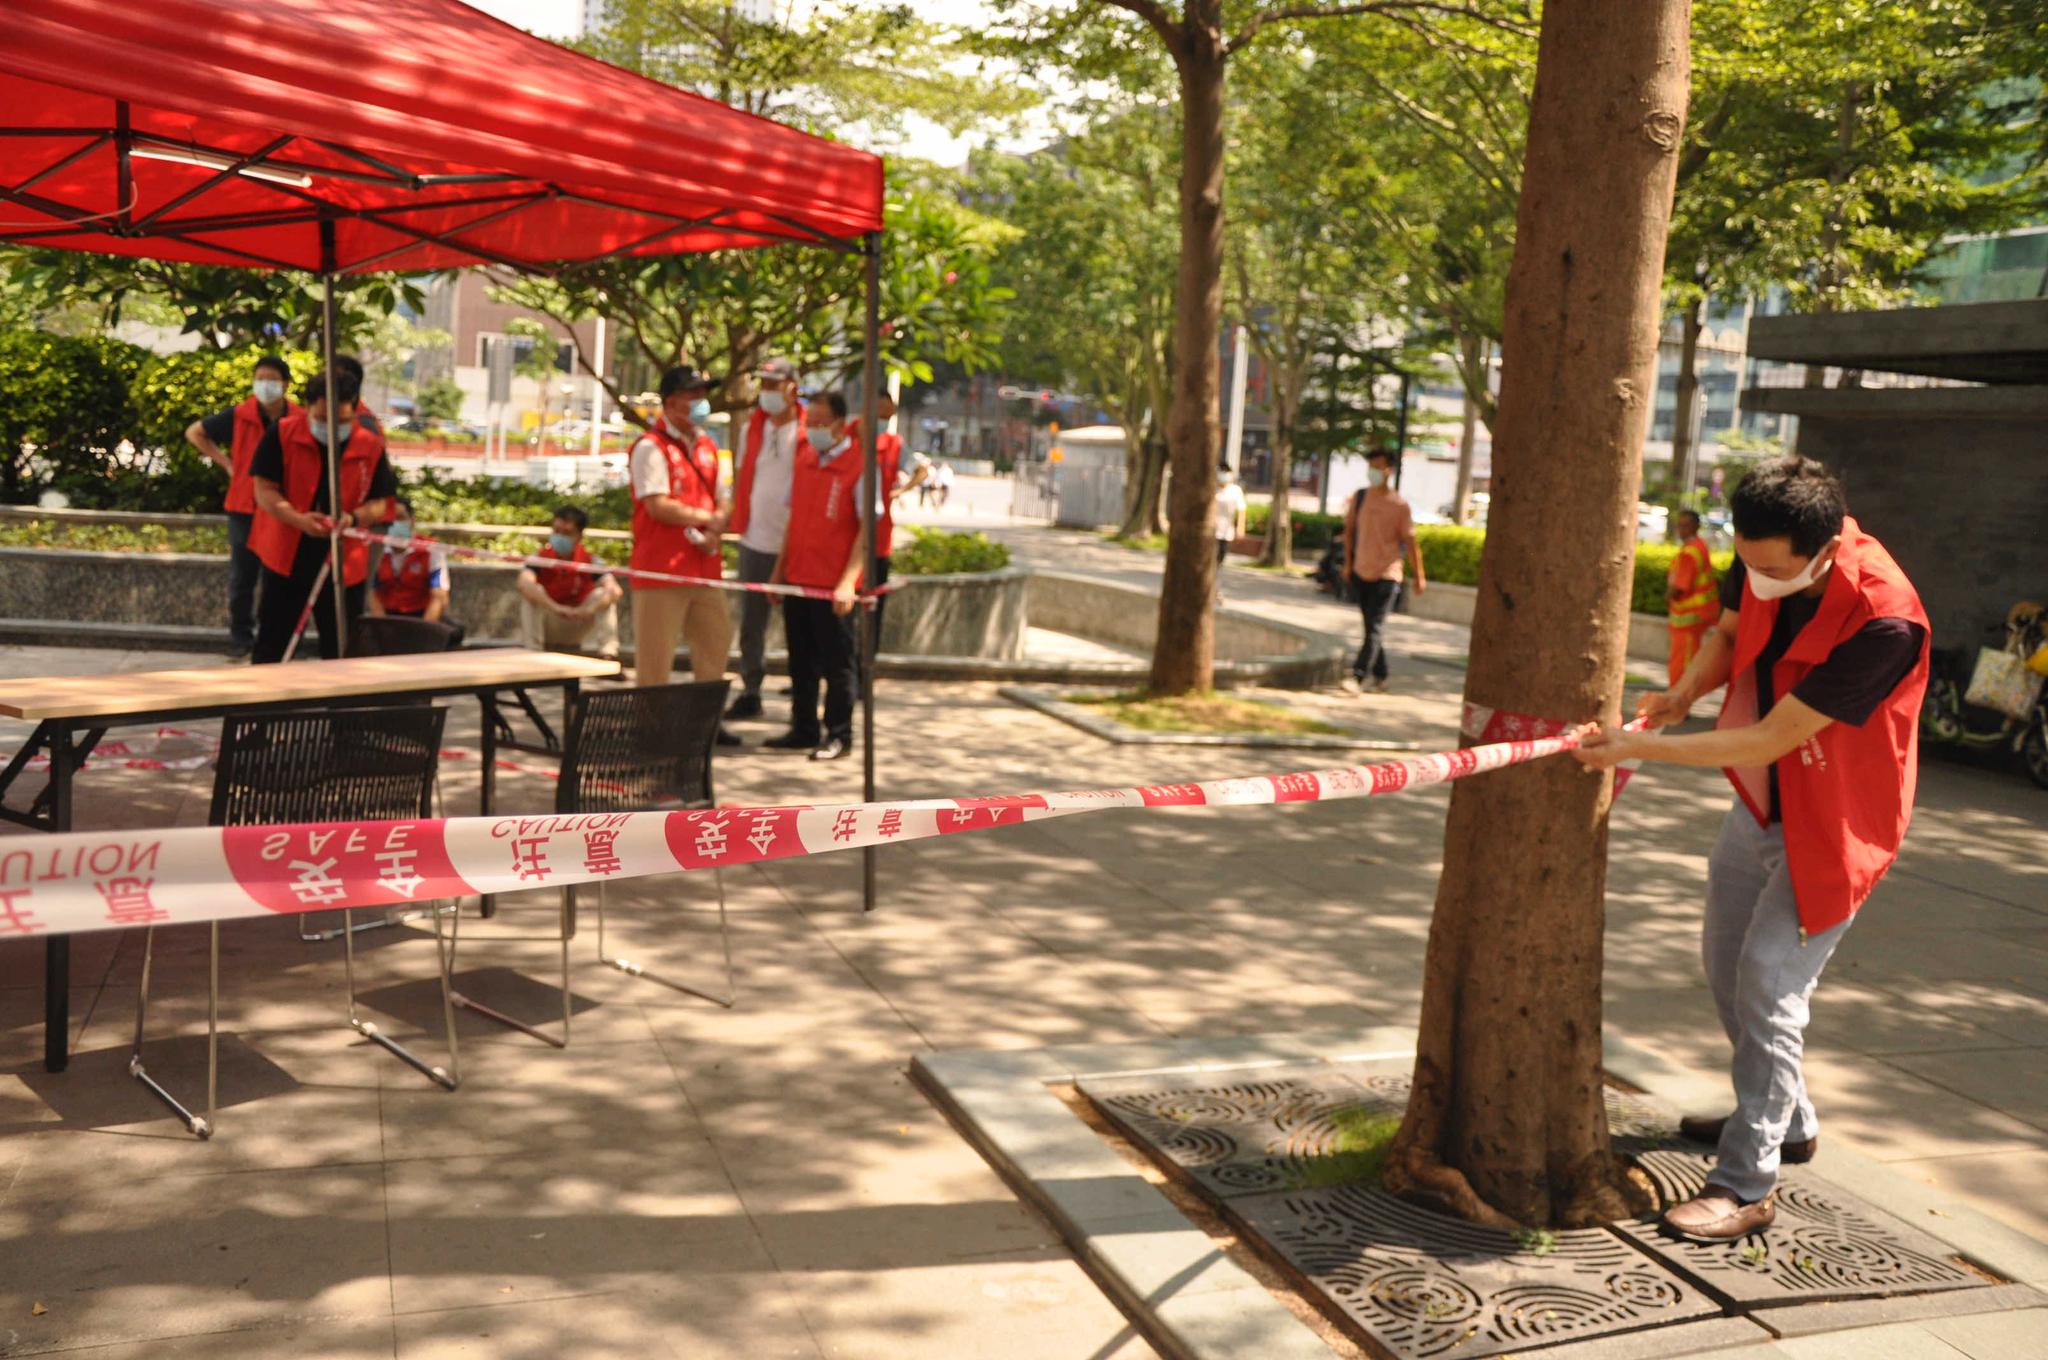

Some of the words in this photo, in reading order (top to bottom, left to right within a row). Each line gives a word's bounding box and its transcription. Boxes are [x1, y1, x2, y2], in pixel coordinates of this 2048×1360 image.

[1276, 777, 1315, 793] SAFE
[1376, 772, 1403, 787] SAFE
[1144, 783, 1198, 798] SAFE
